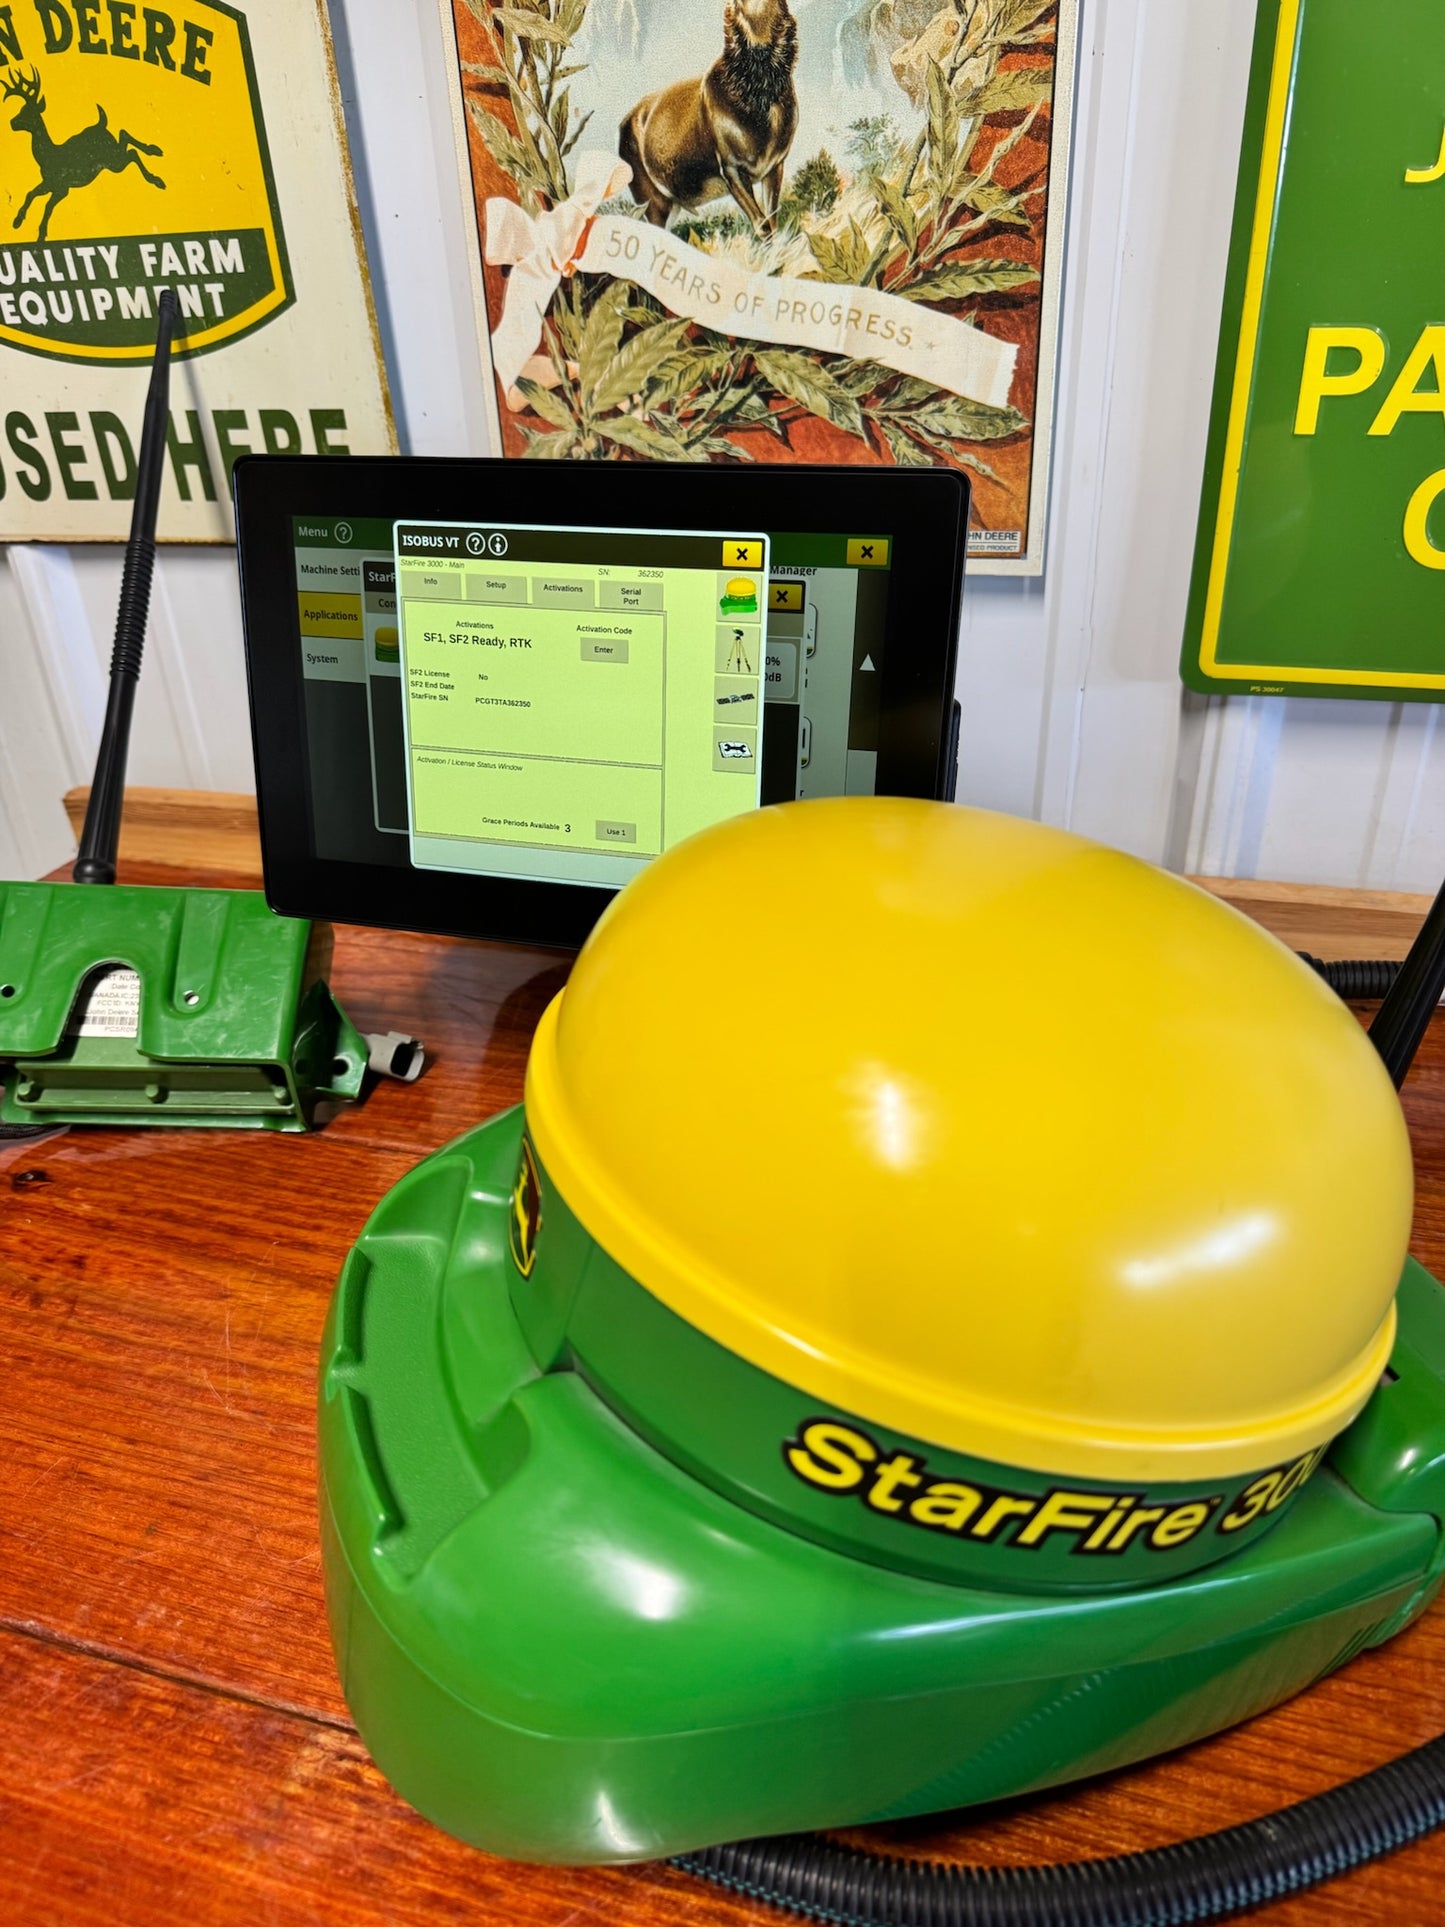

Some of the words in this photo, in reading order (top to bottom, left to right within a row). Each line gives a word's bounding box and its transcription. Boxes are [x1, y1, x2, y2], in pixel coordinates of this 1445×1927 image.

[34, 0, 214, 86] DEERE
[139, 238, 245, 278] FARM
[606, 231, 640, 260] 50
[650, 244, 721, 304] YEARS
[734, 292, 765, 316] OF
[298, 526, 329, 538] Menu
[985, 531, 1019, 541] DEERE
[402, 534, 443, 548] ISOBUS
[445, 536, 460, 549] VT
[400, 558, 426, 567] StarFire
[427, 560, 444, 568] 3000
[448, 561, 465, 569] Main
[301, 564, 338, 576] Machine
[598, 568, 611, 576] SN:
[638, 569, 664, 579] 362350
[770, 565, 818, 577] Manager
[424, 577, 438, 586] Info
[486, 580, 507, 590] Setup
[543, 583, 583, 593] Activations
[620, 587, 642, 597] Serial
[623, 597, 639, 606] Port
[304, 609, 359, 622] Applications
[456, 620, 494, 630] Activations
[576, 624, 613, 634] Activation
[613, 626, 633, 635] Code
[423, 631, 447, 645] SF1,
[449, 633, 469, 645] SF2
[472, 635, 507, 649] Ready,
[509, 637, 532, 649] RTK
[594, 645, 614, 654] Enter
[306, 653, 339, 665] System
[410, 668, 423, 676] SF2
[424, 670, 451, 679] License
[478, 673, 489, 681] No
[410, 680, 423, 689] SF2
[425, 681, 438, 690] End
[440, 682, 455, 691] Date
[411, 692, 437, 701] StarFire
[438, 693, 449, 702] SN
[417, 755, 447, 765] Activation
[451, 758, 476, 768] License
[476, 760, 497, 770] Status
[498, 762, 523, 772] Window
[482, 816, 502, 826] Grace
[503, 818, 528, 828] Periods
[530, 820, 560, 831] Available
[564, 824, 571, 834] 3
[606, 828, 619, 837] Use
